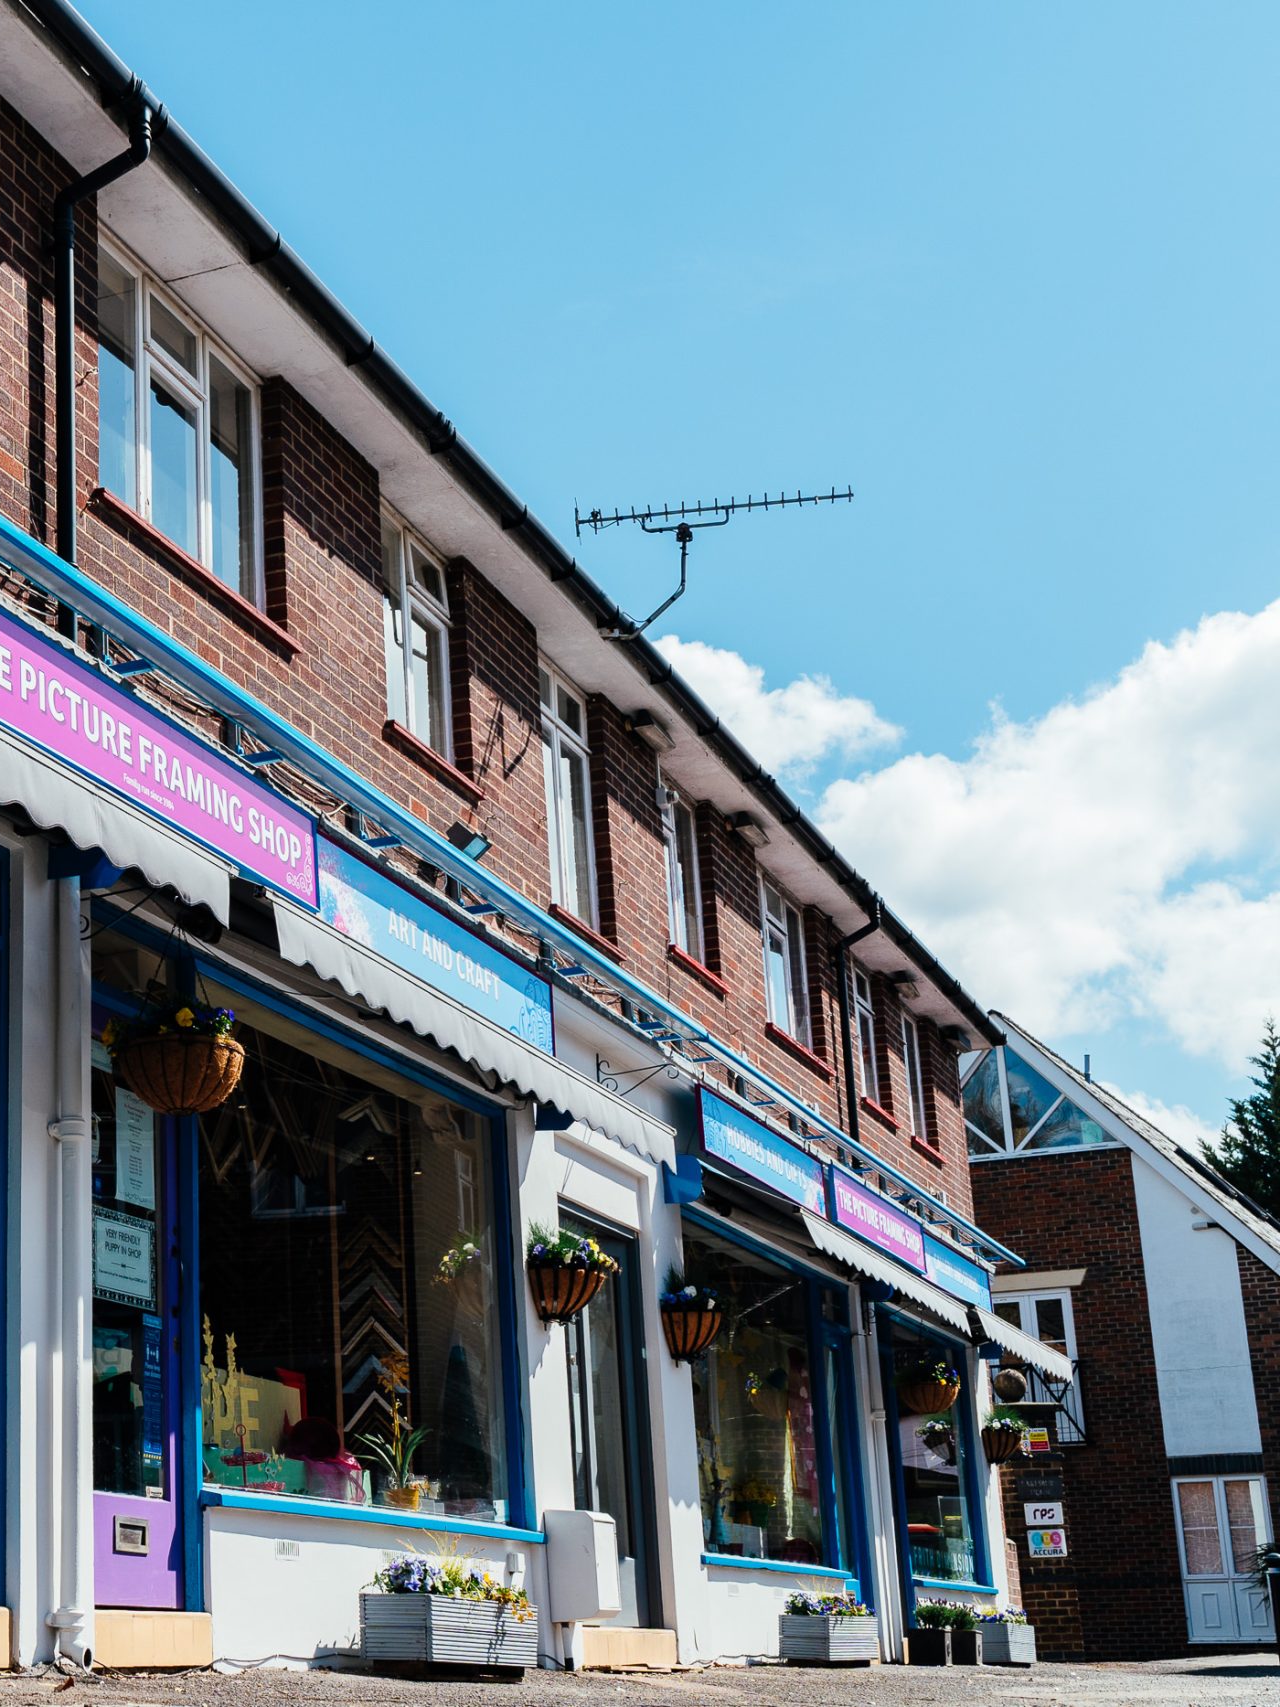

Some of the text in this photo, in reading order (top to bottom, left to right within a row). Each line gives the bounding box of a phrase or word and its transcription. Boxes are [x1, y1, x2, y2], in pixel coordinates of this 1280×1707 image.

[20, 658, 133, 765] PICTURE
[138, 734, 244, 835] FRAMING
[248, 808, 303, 868] SHOP
[123, 772, 141, 793] Family
[388, 907, 501, 1000] ART AND CRAFT
[726, 1122, 808, 1191] HOBBIES AND GIFTS
[838, 1186, 853, 1214] THE
[852, 1195, 880, 1230] PICTURE
[879, 1212, 907, 1246] FRAMING
[905, 1229, 921, 1255] SHOP
[105, 1227, 141, 1246] VERY FRIENDLY
[105, 1240, 142, 1260] PUPPY IN SHOP
[1033, 1508, 1055, 1520] rps
[1033, 1548, 1064, 1556] ACCURA
